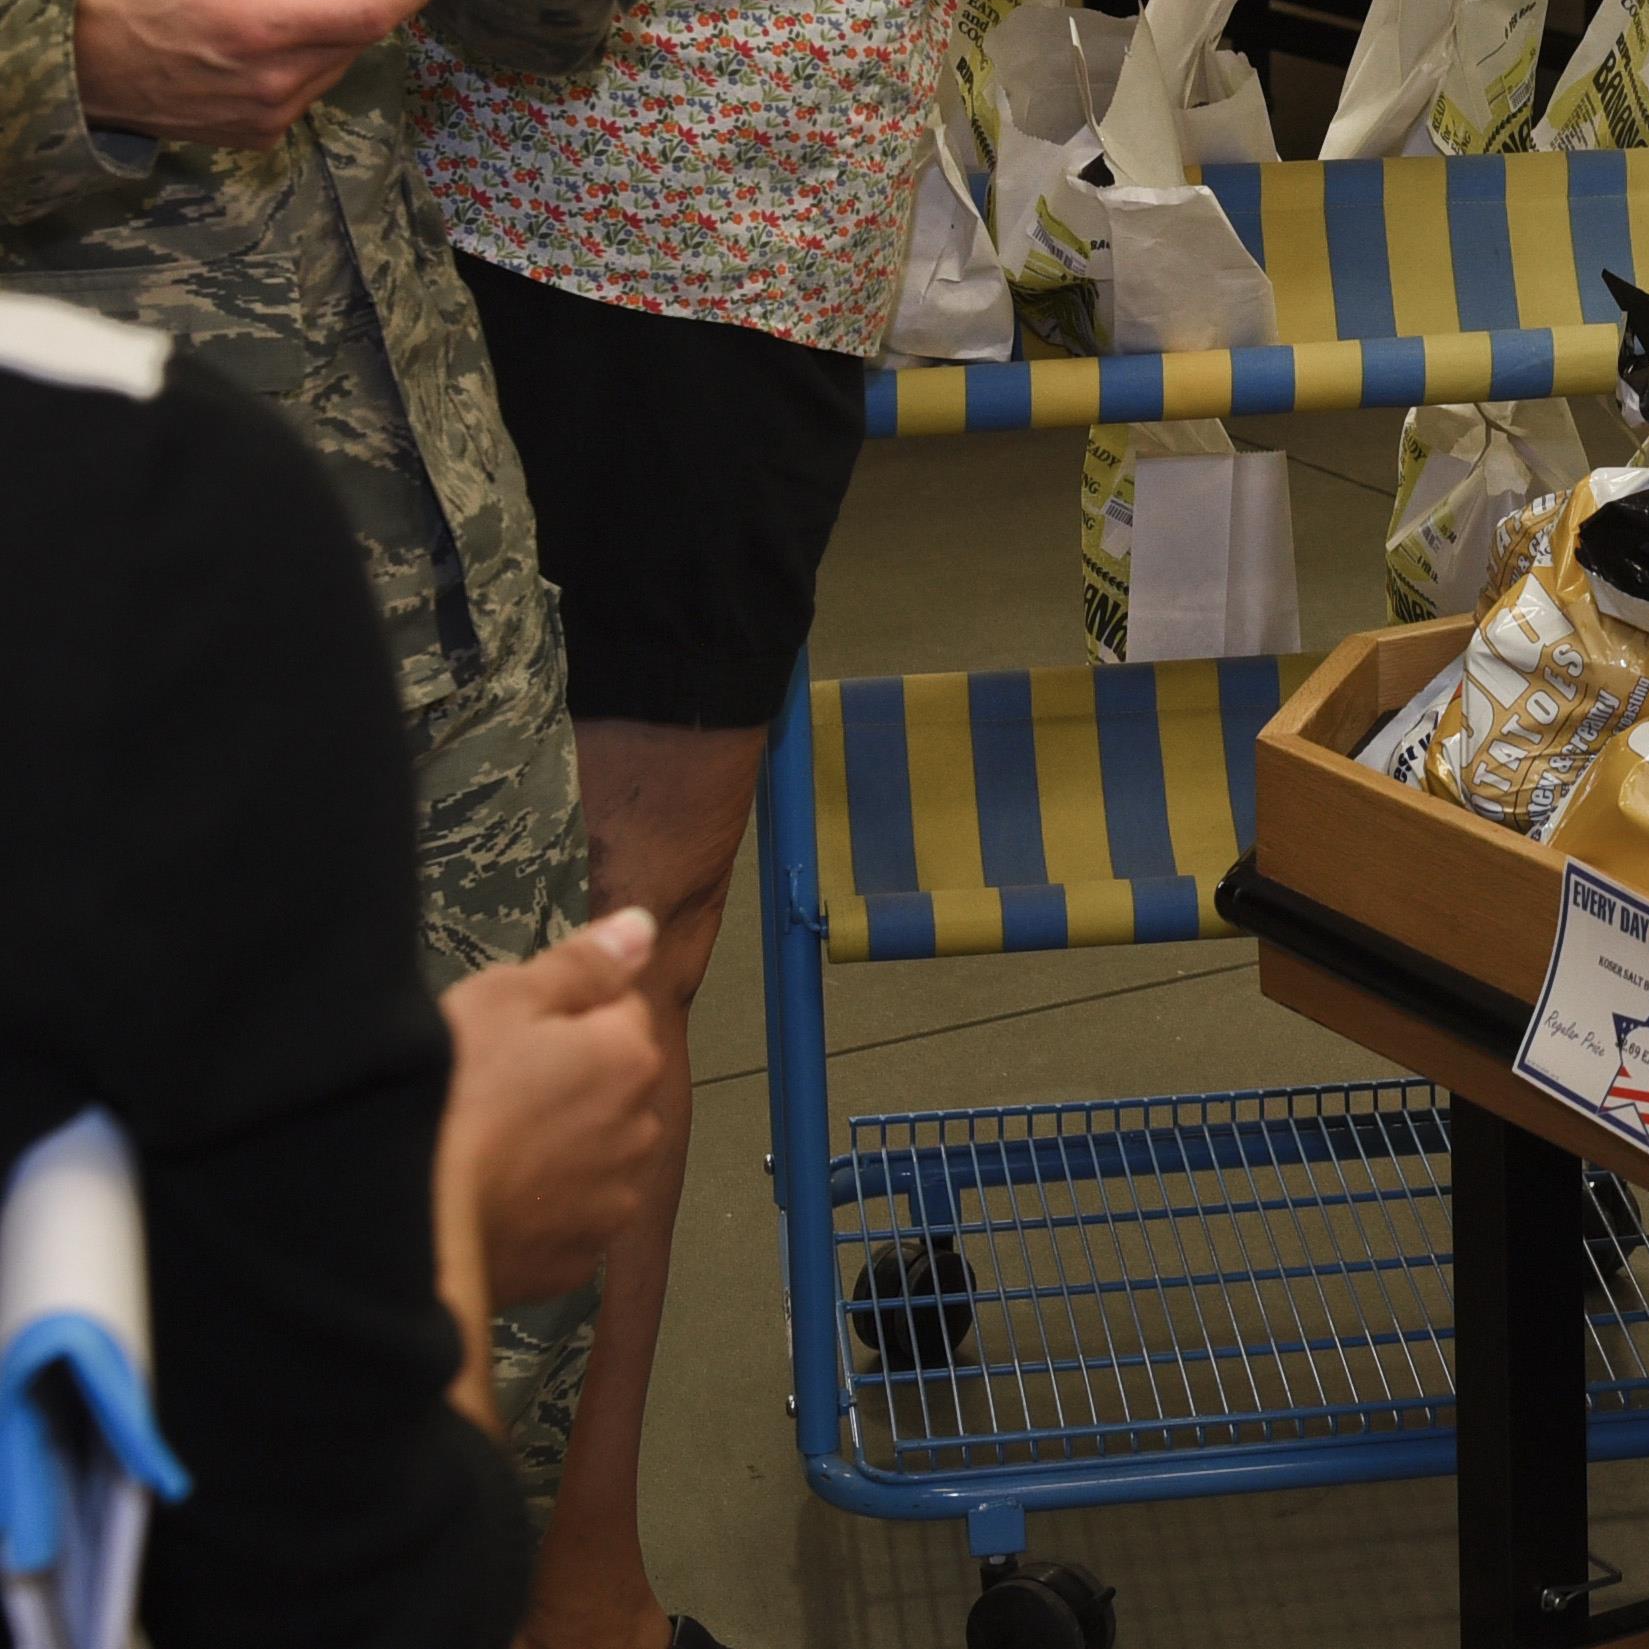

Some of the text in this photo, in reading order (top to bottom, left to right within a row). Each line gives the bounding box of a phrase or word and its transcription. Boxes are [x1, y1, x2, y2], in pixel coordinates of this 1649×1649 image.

[1573, 880, 1617, 926] EVERY
[1620, 909, 1648, 943] DAY
[1598, 956, 1622, 978] KOSER
[1623, 967, 1643, 989] SALT
